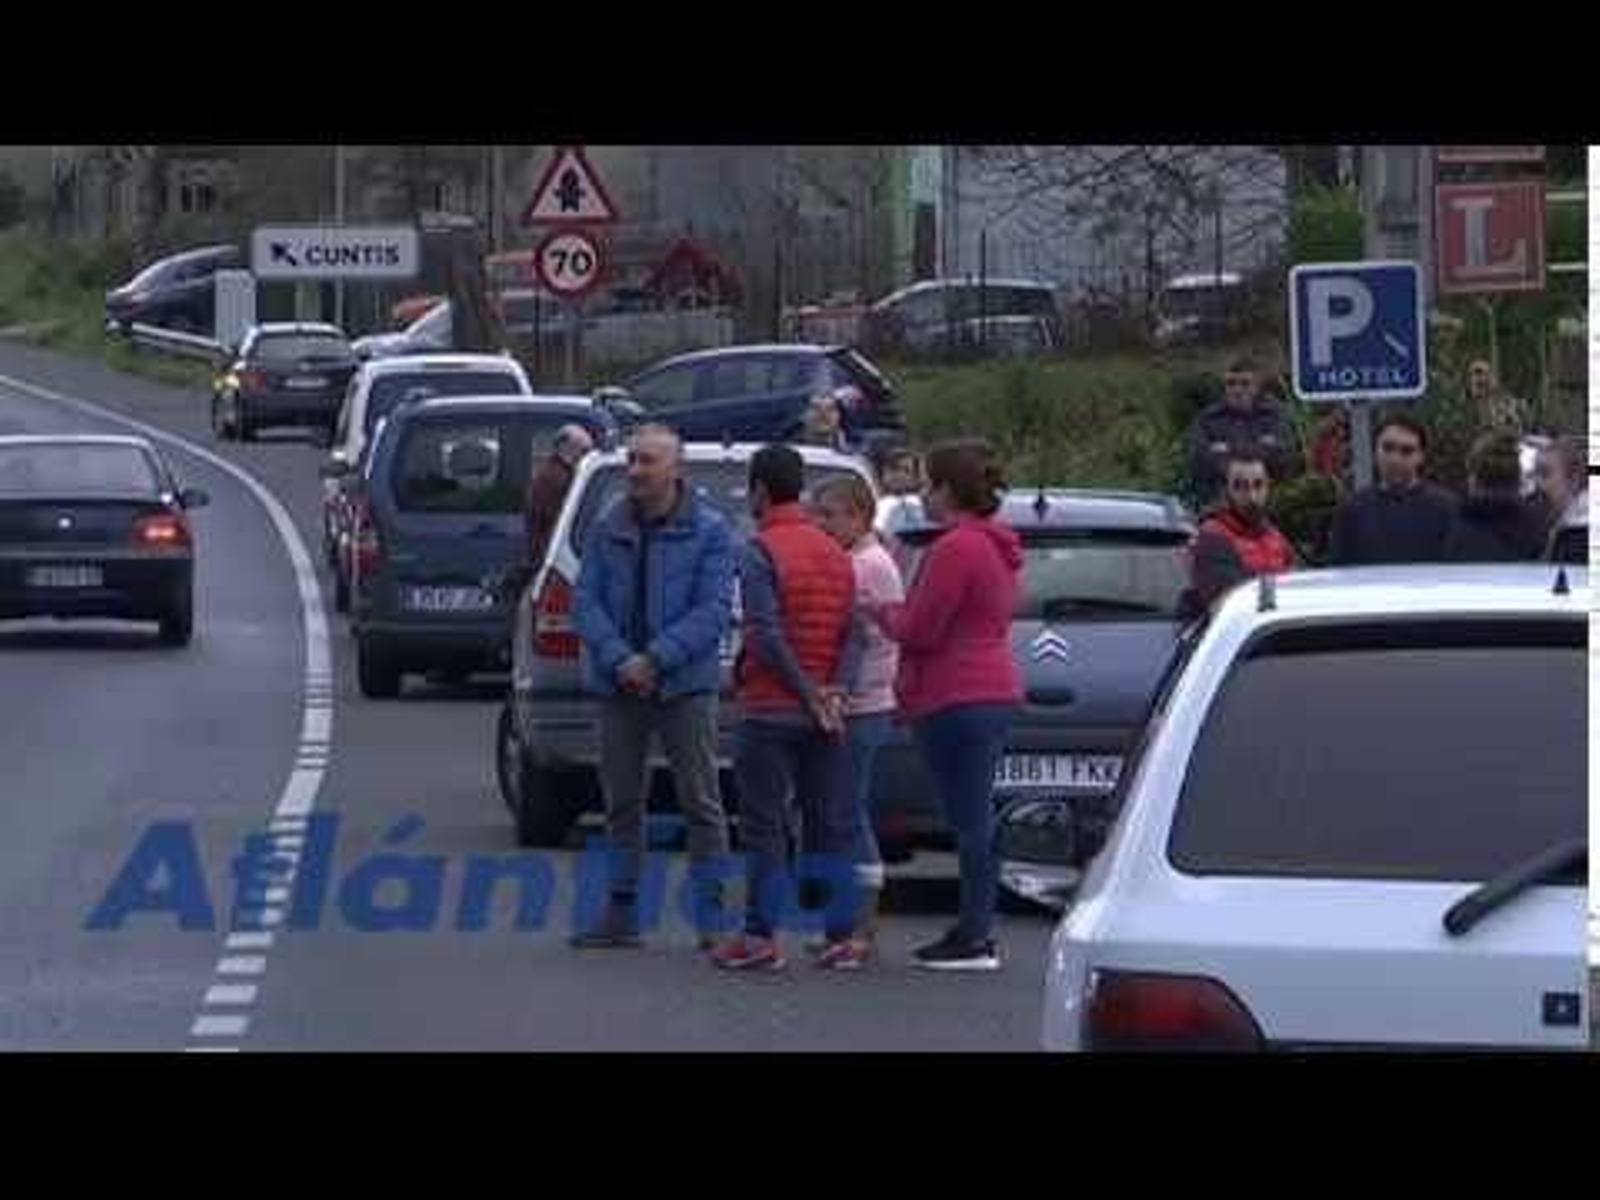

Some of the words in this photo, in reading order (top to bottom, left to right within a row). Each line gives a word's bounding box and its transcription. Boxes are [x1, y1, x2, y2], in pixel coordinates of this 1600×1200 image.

[1452, 197, 1526, 276] L
[304, 244, 400, 266] CUNTIS
[549, 249, 592, 278] 70
[1307, 276, 1373, 366] P
[1319, 368, 1408, 387] HOTEL
